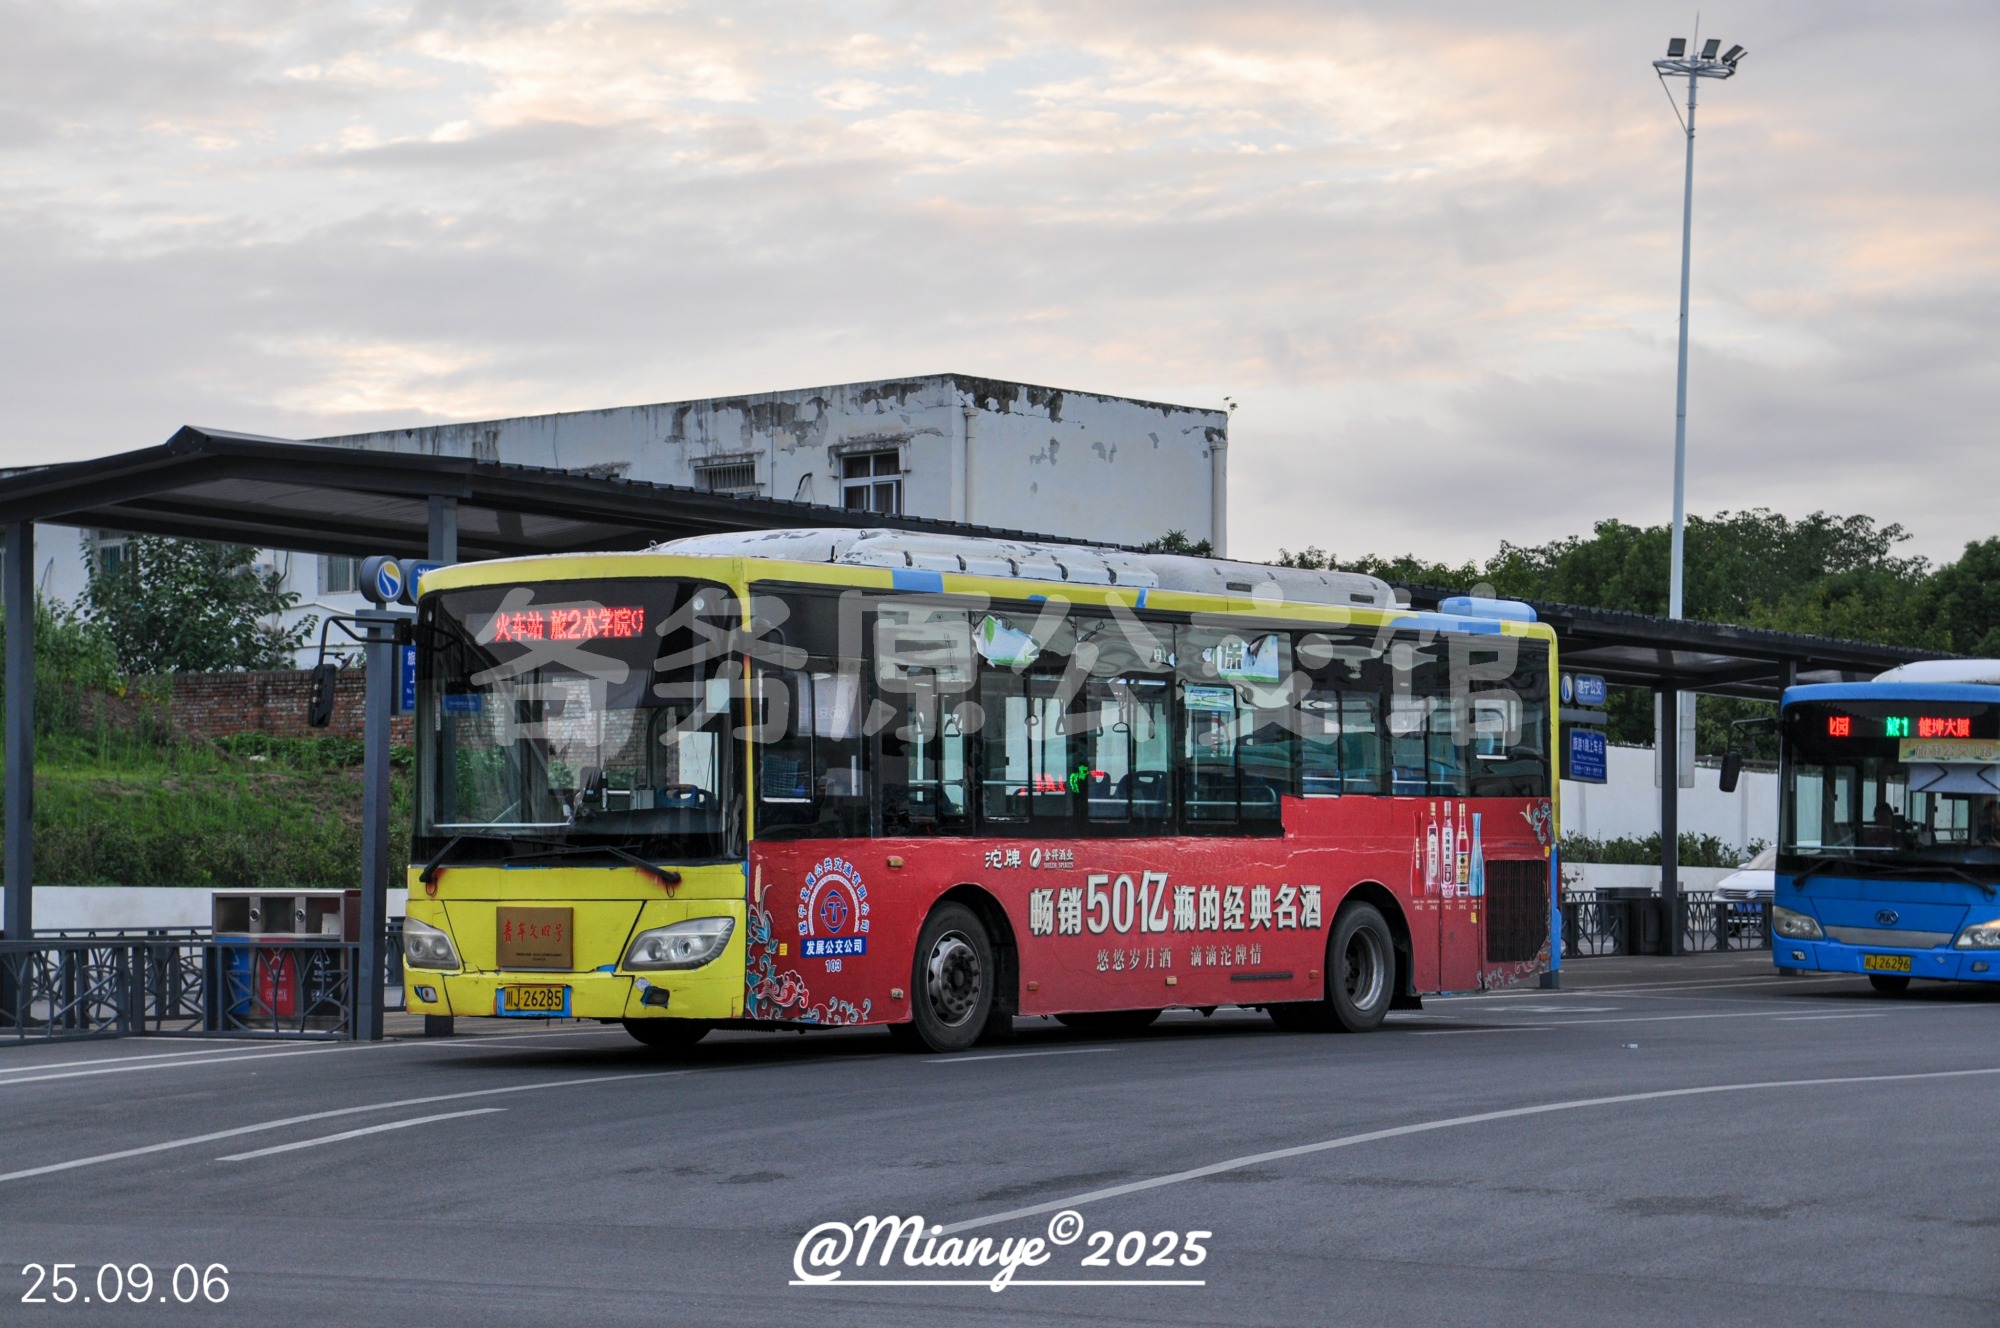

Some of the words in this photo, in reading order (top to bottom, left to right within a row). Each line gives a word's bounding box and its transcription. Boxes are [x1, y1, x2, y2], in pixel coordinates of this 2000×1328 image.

[495, 611, 544, 642] 火车站
[985, 848, 1022, 869] 沱牌
[1030, 870, 1322, 935] 畅销50亿瓶的经典名酒
[806, 939, 862, 955] 发展公交公司
[1096, 947, 1172, 972] 悠悠岁月酒
[1190, 943, 1262, 967] 滴滴沱牌情
[825, 959, 842, 972] 103
